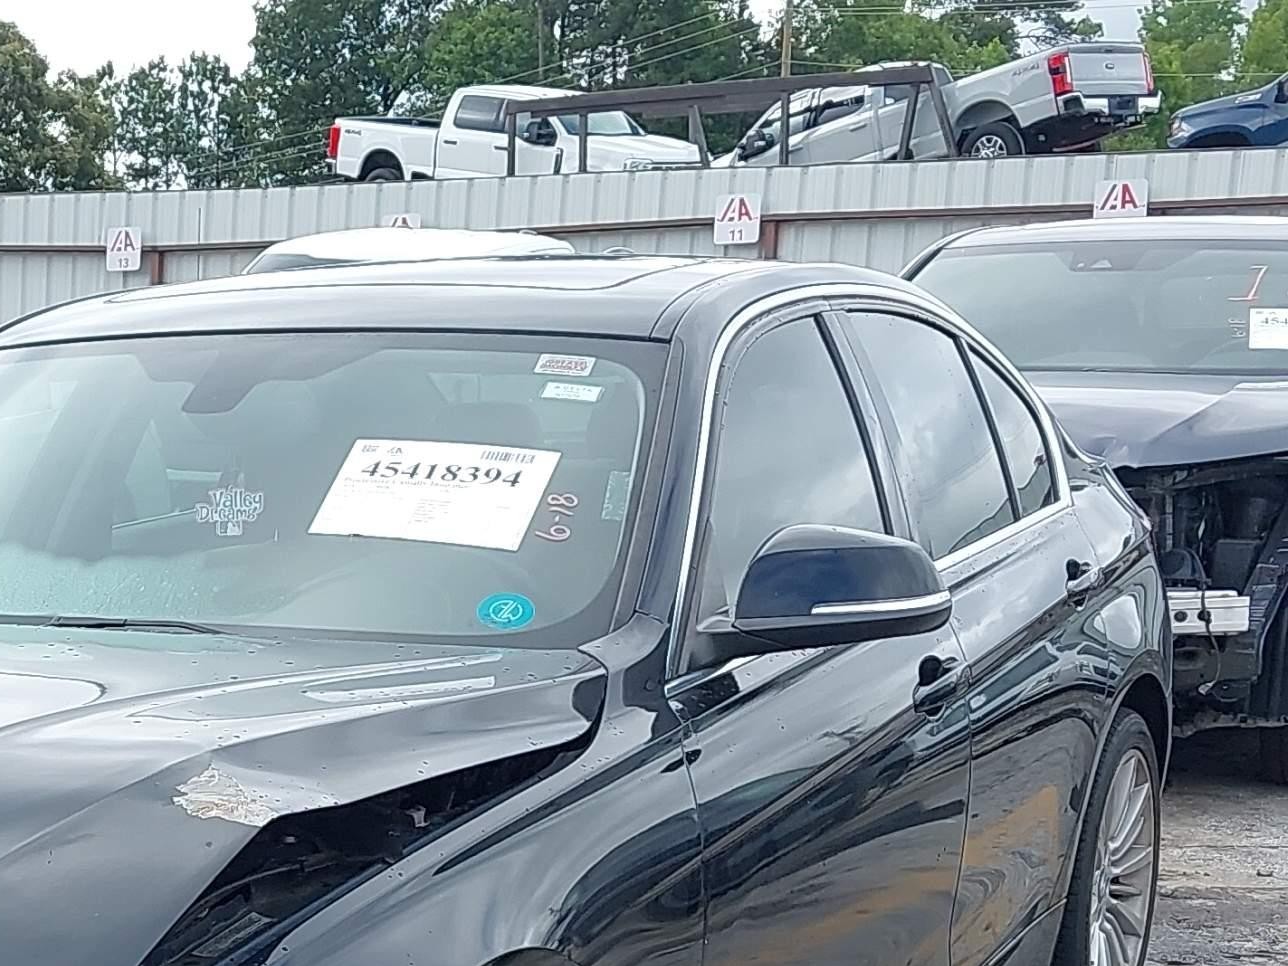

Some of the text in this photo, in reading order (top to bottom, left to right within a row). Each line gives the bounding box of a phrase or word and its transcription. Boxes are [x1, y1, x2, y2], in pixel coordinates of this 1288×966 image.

[728, 229, 743, 241] 11
[118, 258, 129, 268] 13
[361, 460, 523, 488] 45418394
[208, 486, 263, 514] Valley
[534, 493, 580, 543] 6-18
